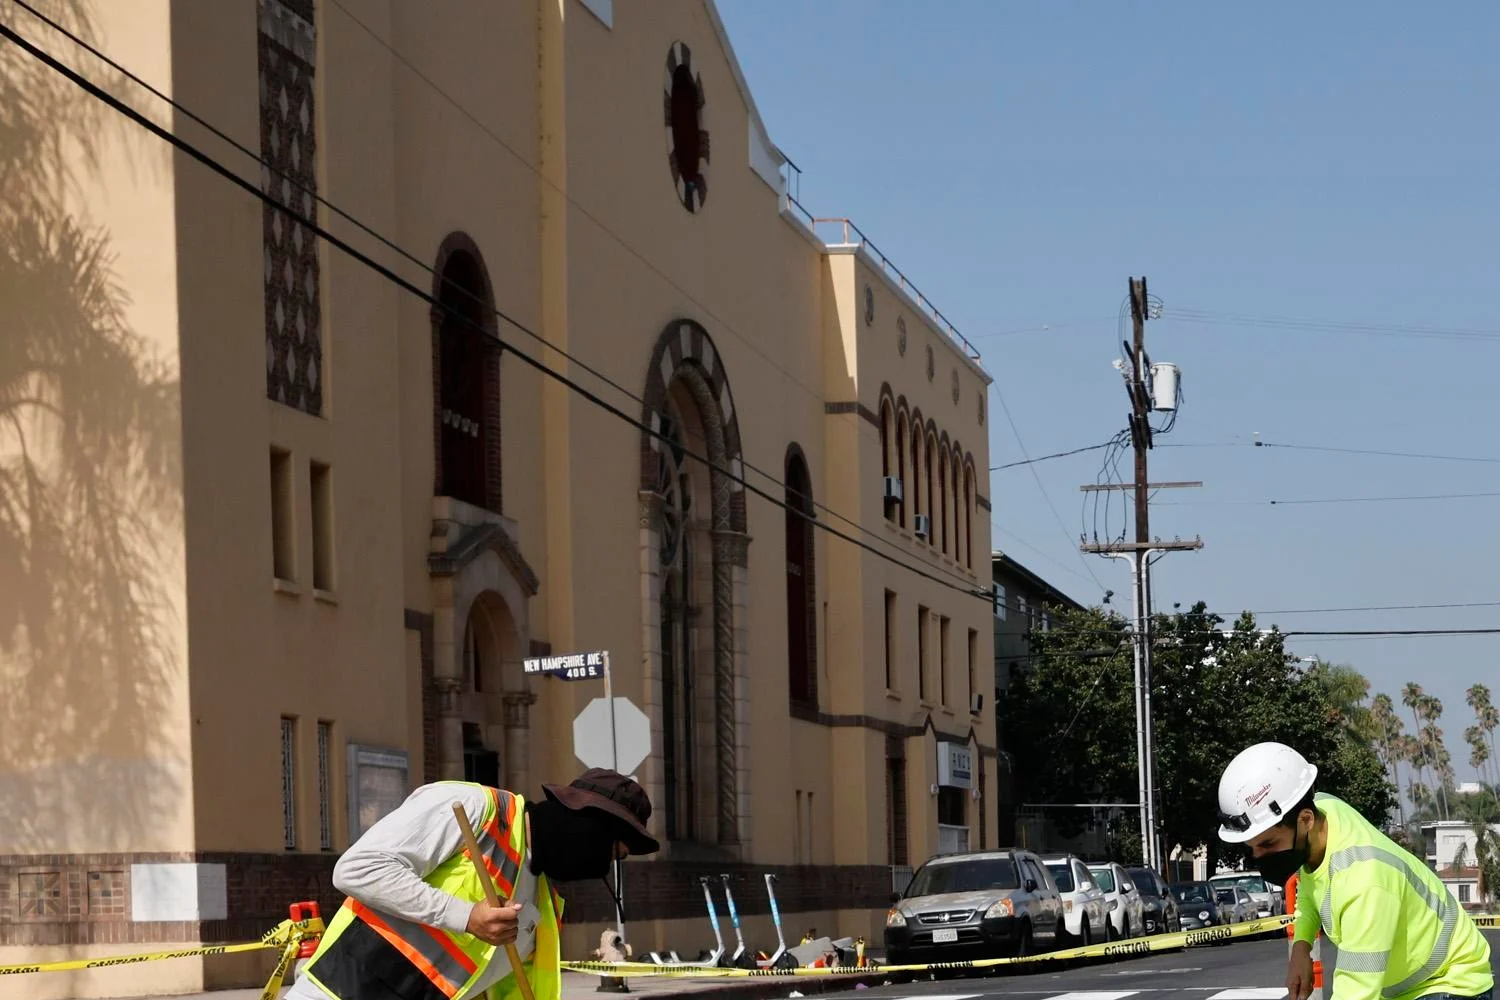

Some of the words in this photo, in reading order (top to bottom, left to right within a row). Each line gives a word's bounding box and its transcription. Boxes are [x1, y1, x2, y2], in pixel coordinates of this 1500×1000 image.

[524, 659, 540, 672] NEW
[541, 654, 585, 671] HAMPSHIRE
[566, 667, 586, 678] 400
[588, 666, 598, 676] S.
[1185, 926, 1232, 946] CUIDADO
[1104, 941, 1150, 958] CAUTION
